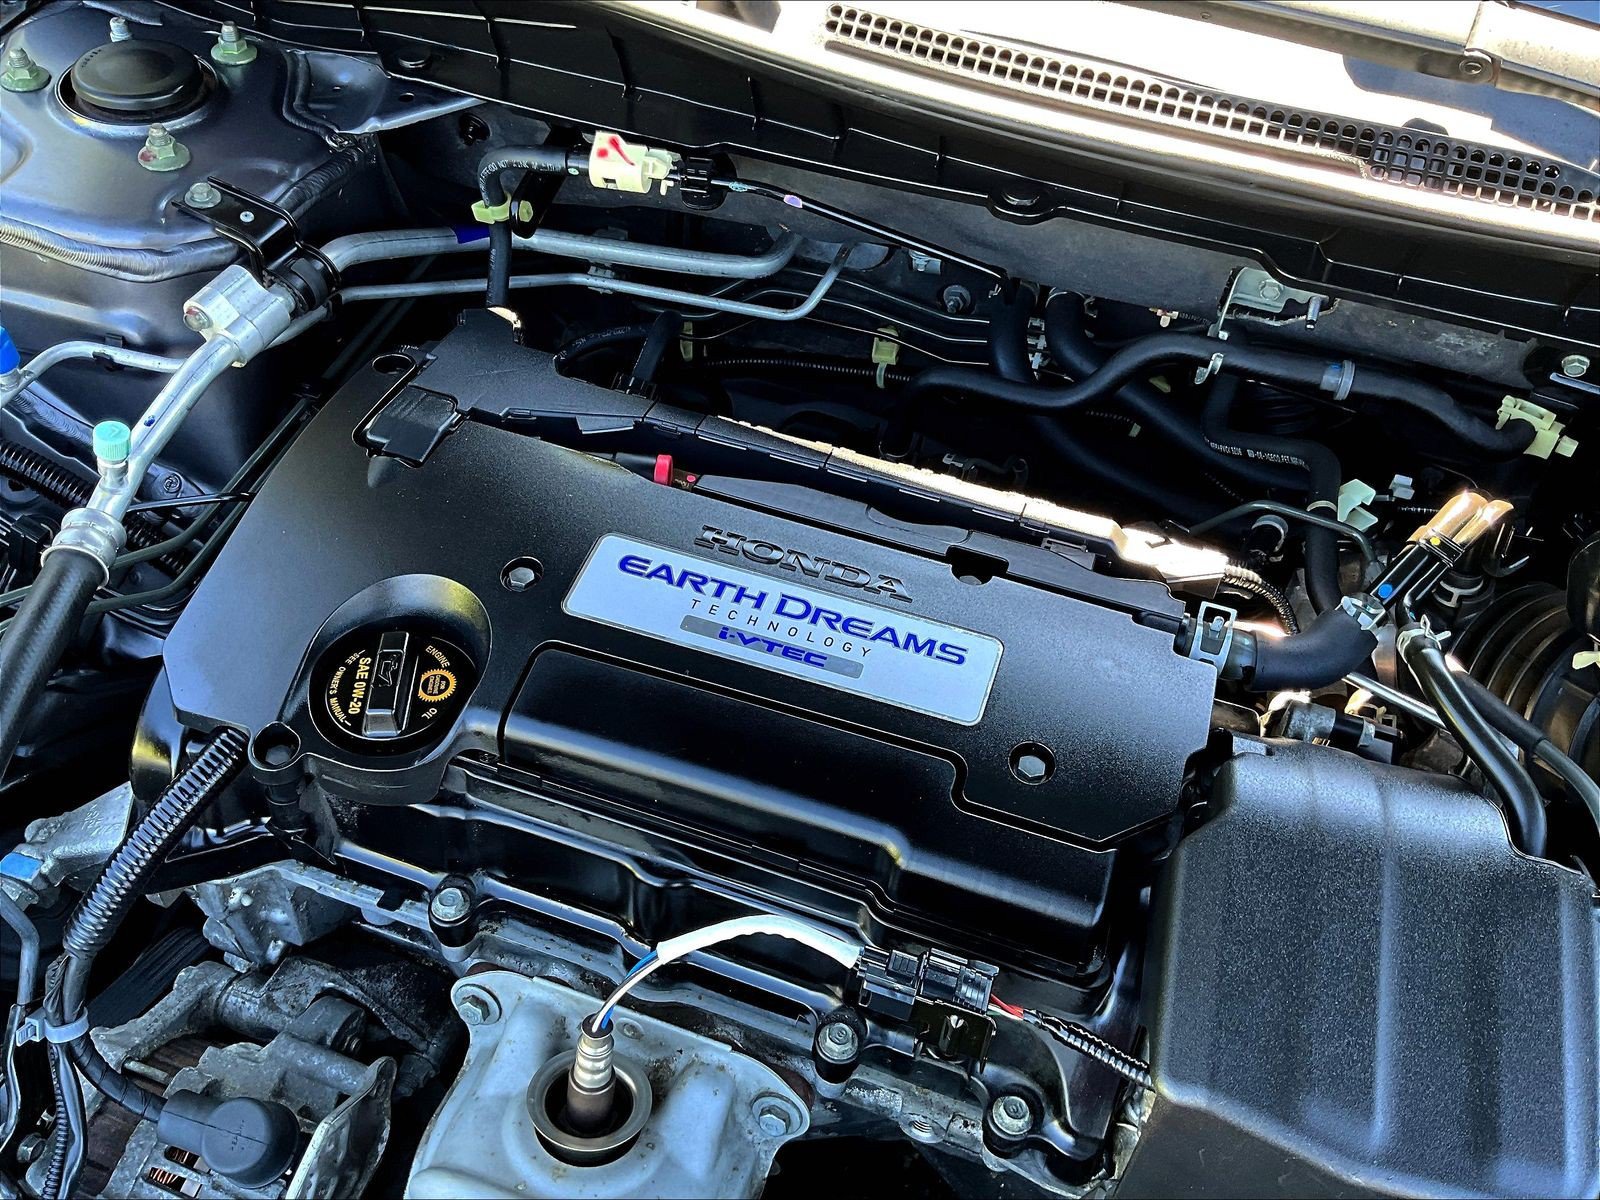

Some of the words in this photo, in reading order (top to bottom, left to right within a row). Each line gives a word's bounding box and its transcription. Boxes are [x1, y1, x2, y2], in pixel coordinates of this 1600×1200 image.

[694, 524, 913, 603] HONDA
[617, 554, 767, 611] EARTH
[774, 592, 967, 667] DREAMS
[691, 598, 872, 657] TECHNOLOGY
[344, 652, 361, 666] SEE
[355, 657, 372, 680] SAE
[425, 645, 450, 668] ENGINE
[329, 666, 347, 695] OWNER'S
[329, 697, 347, 723] MANUAL
[348, 681, 367, 715] 0W-20
[421, 707, 438, 720] OIL
